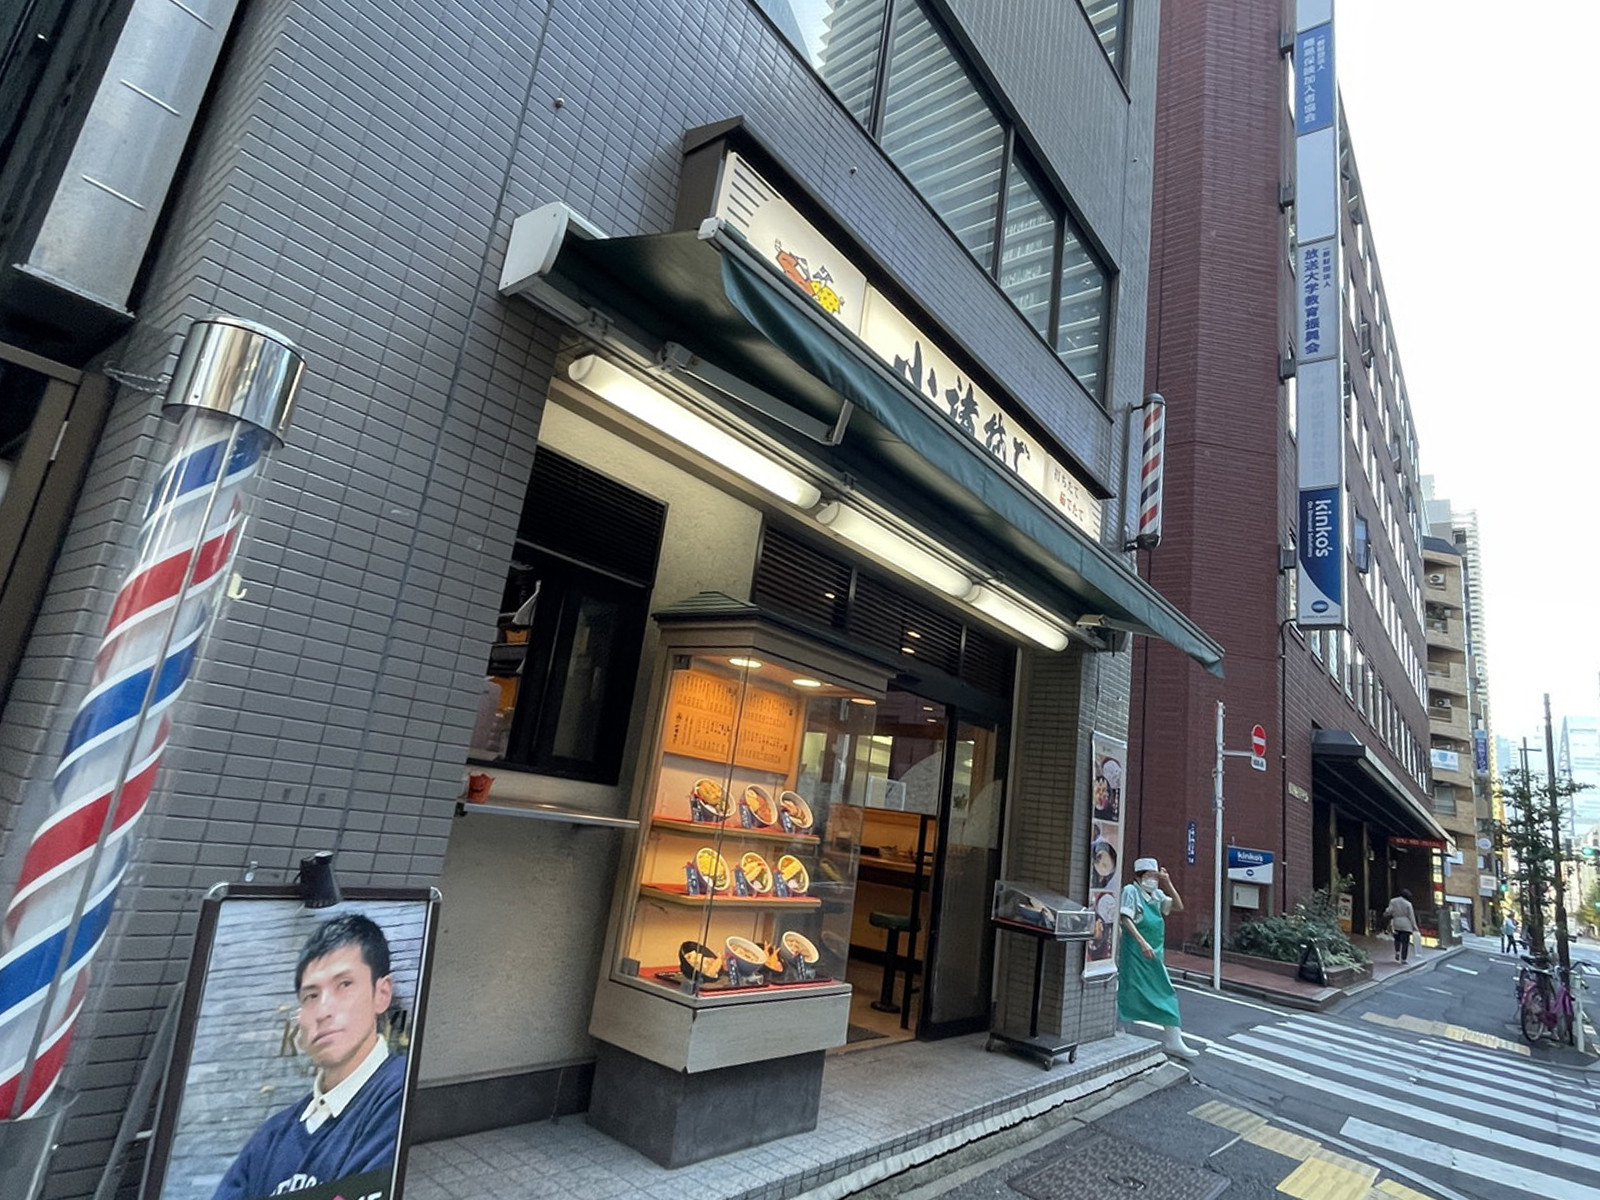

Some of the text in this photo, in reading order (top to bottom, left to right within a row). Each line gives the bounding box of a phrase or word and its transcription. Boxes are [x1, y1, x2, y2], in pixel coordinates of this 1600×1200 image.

[1304, 248, 1321, 355] 放送大学教育振興会
[1315, 499, 1333, 557] kinko's
